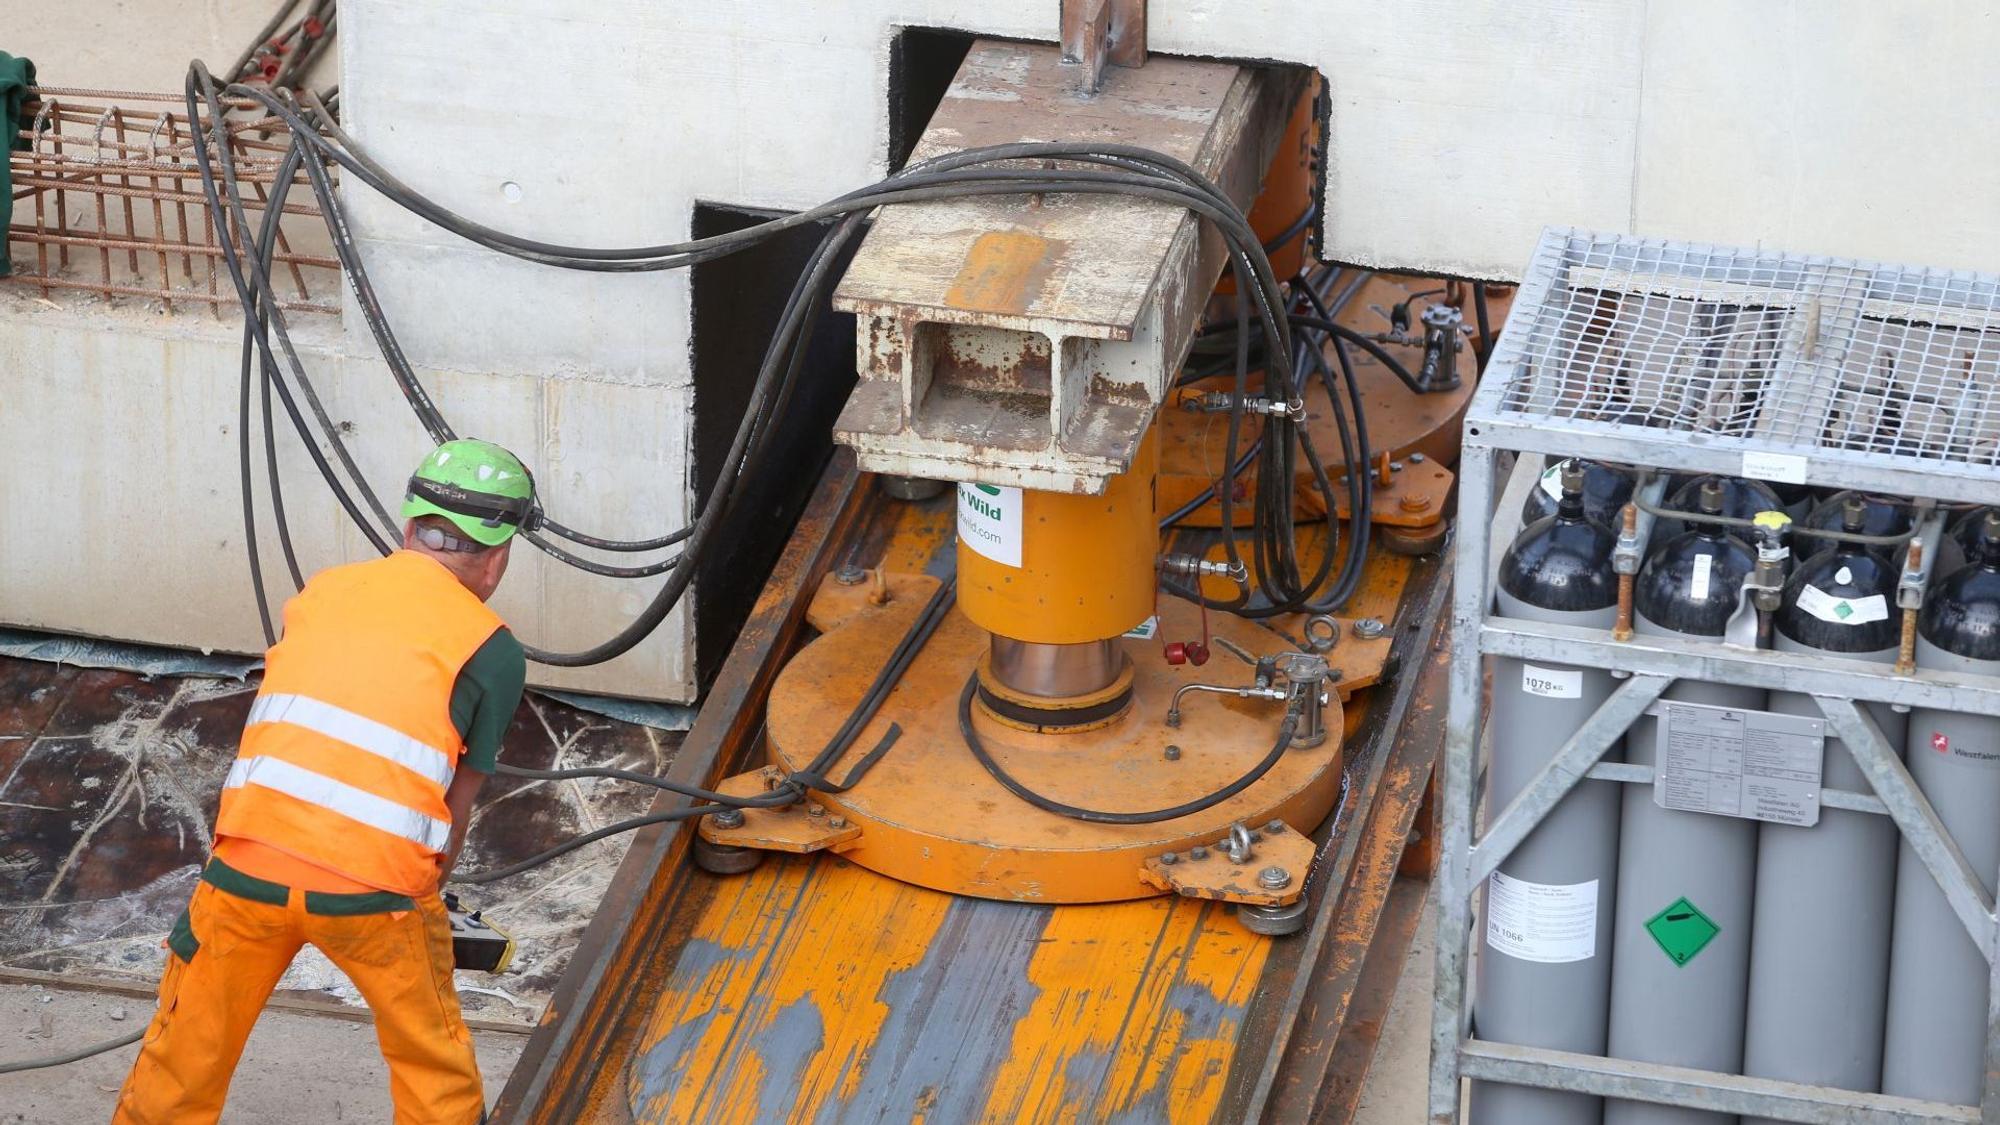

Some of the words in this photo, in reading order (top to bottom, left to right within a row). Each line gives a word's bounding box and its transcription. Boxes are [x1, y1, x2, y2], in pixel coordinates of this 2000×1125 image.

[967, 491, 1001, 521] Wild
[1526, 677, 1552, 690] 1078
[1954, 747, 2000, 760] Westfalen
[1489, 921, 1499, 933] UN
[1502, 927, 1524, 942] 1066
